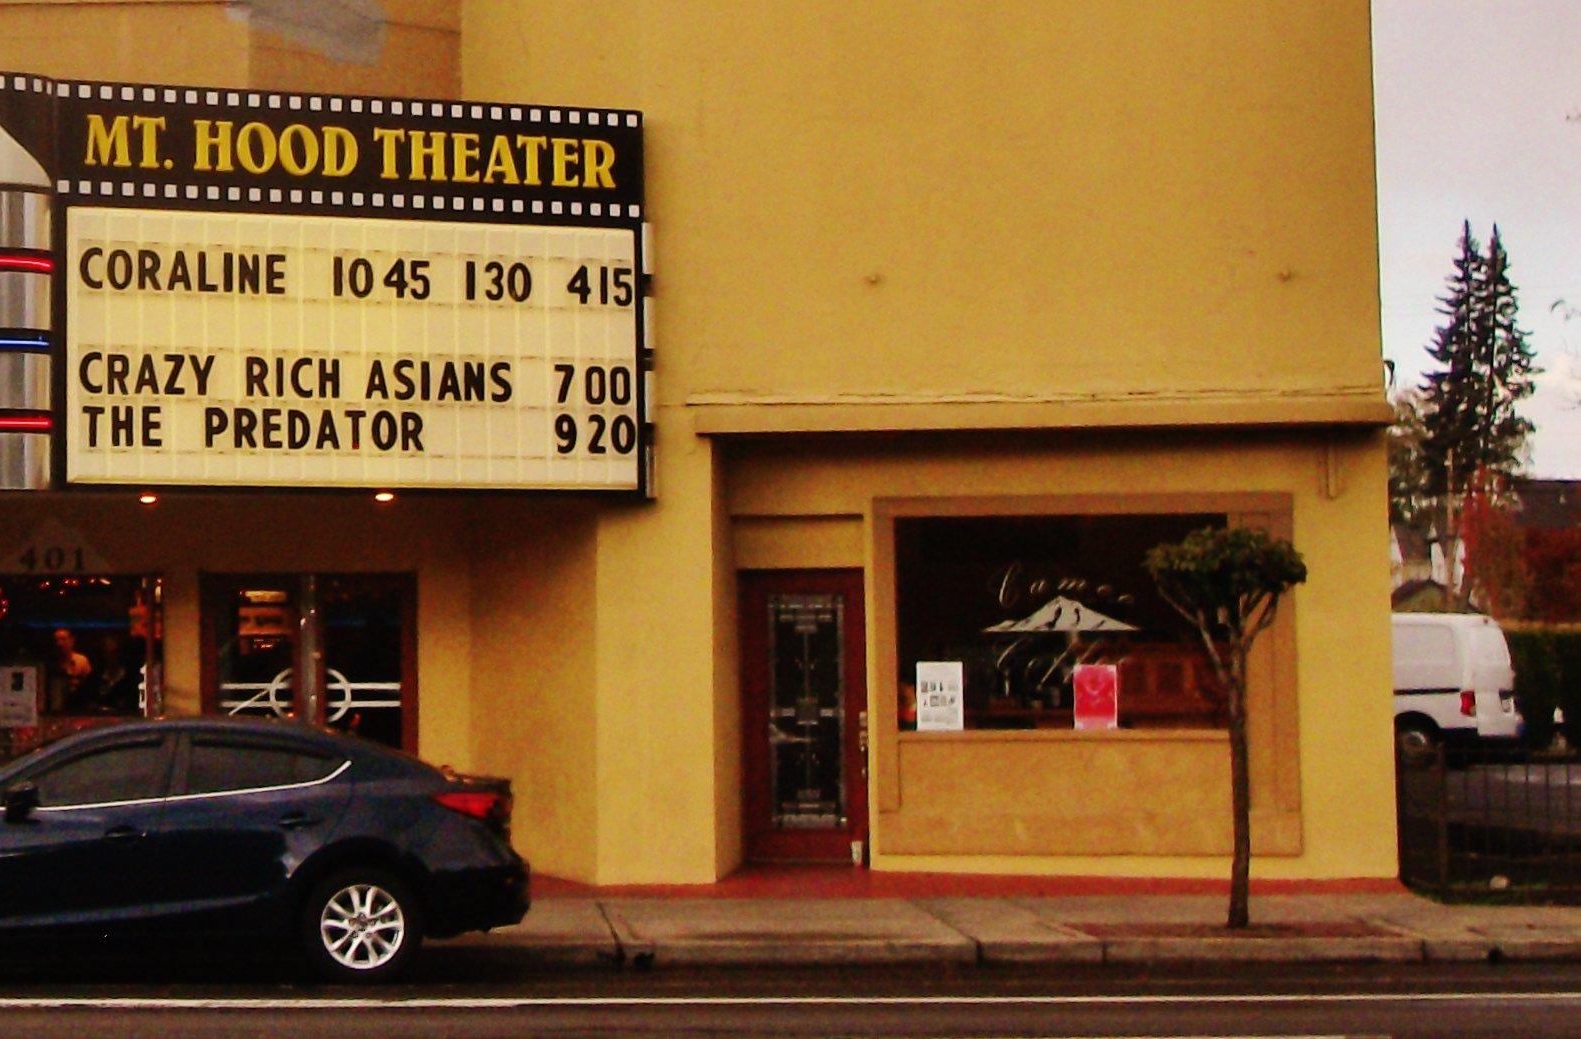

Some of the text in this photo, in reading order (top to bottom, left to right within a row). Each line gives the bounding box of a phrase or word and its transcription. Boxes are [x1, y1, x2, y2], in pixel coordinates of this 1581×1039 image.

[85, 115, 615, 187] MT. HOOD THEATER
[80, 247, 632, 306] CORALINE 1045 130 415
[79, 352, 630, 405] CRAZY RICH ASIANS 700
[83, 406, 636, 454] THE PREDATOR 920
[21, 547, 87, 572] 401
